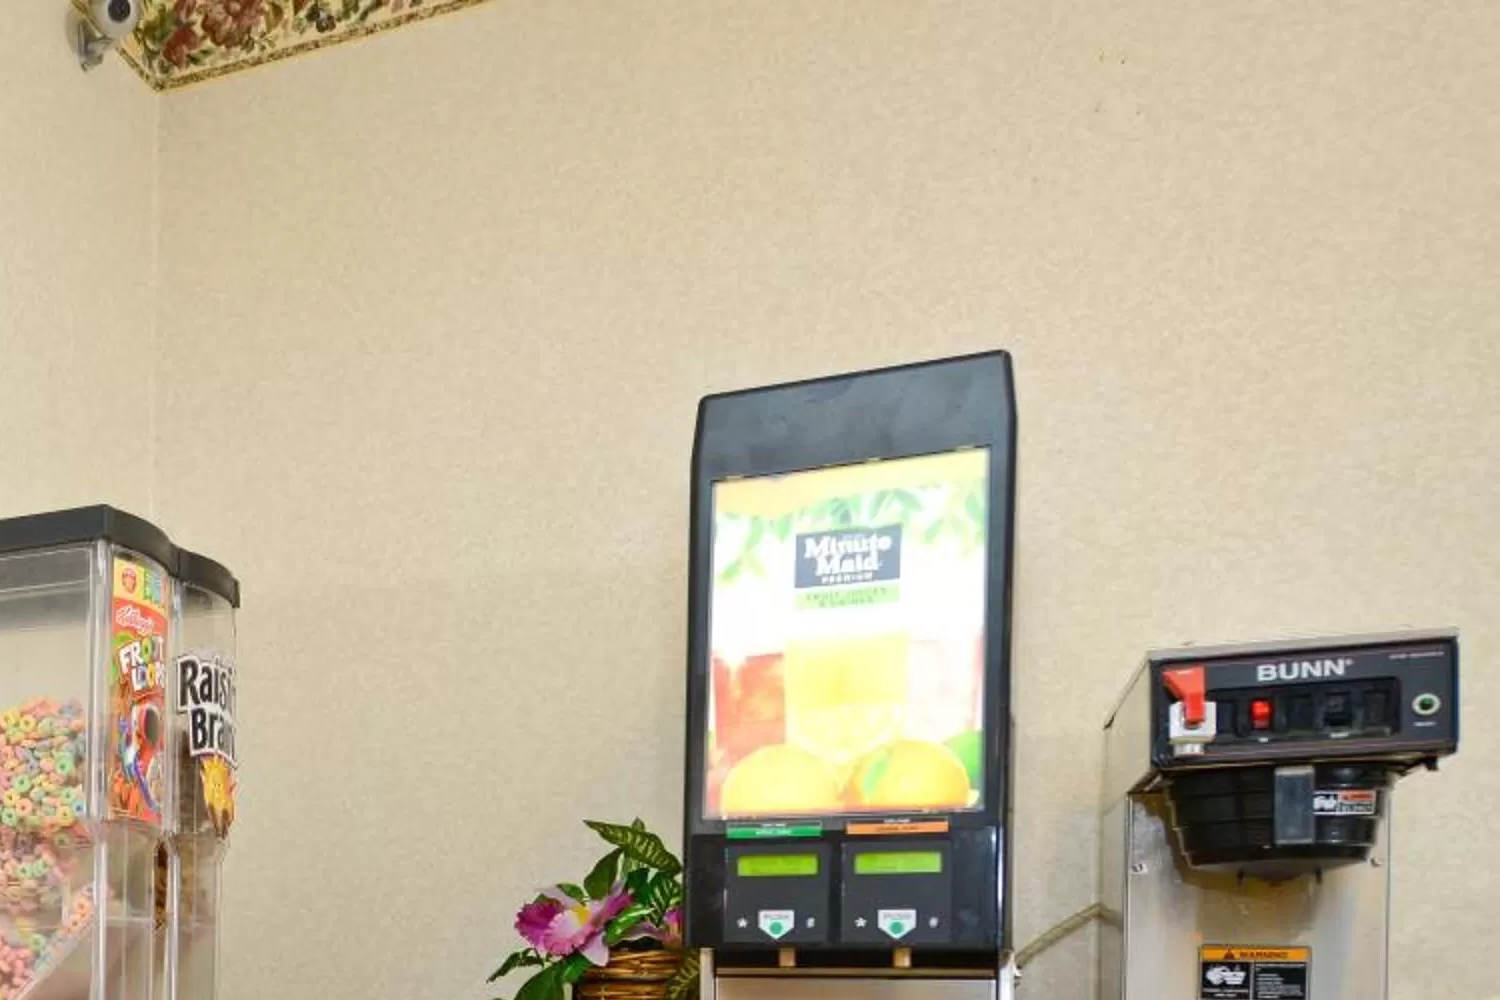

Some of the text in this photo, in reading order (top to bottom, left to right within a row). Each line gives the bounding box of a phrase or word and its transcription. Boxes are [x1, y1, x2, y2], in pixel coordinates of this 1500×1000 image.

[804, 533, 893, 559] Minute
[815, 553, 879, 576] Maid
[1256, 659, 1346, 682] BUNN
